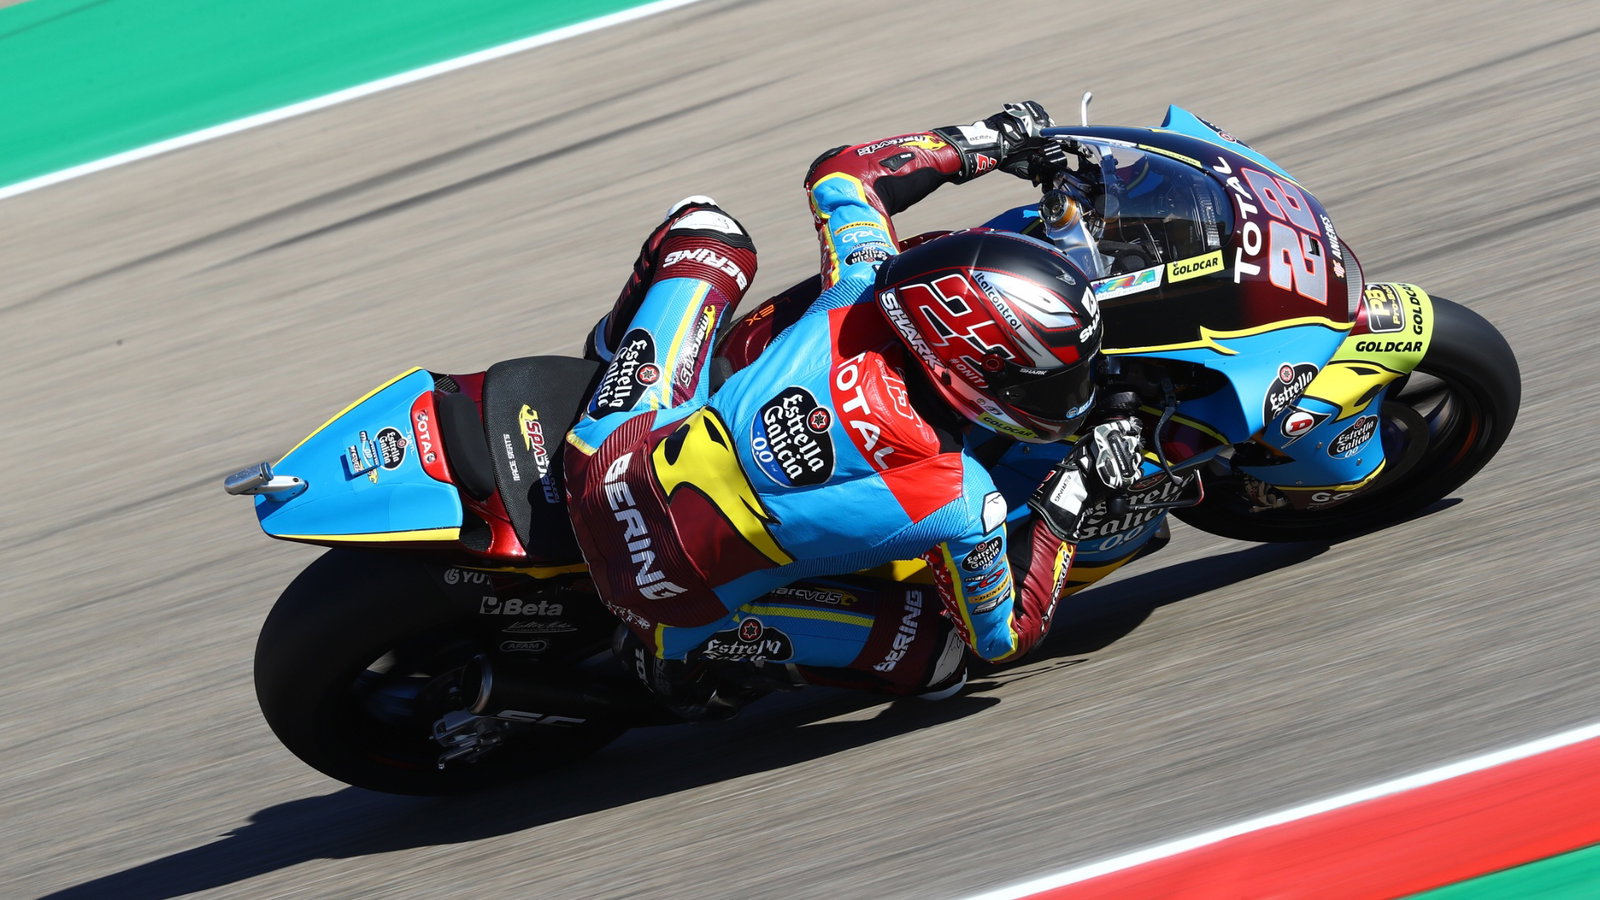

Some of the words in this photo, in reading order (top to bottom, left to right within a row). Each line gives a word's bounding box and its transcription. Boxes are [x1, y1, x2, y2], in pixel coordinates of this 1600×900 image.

[1212, 155, 1262, 284] TOTAL
[1240, 166, 1329, 306] 22
[662, 248, 748, 291] BERING
[1172, 256, 1219, 276] GOLDCAR
[973, 271, 1022, 331] Italcontrol
[880, 292, 948, 370] SHARK
[1079, 315, 1101, 343] SHA
[1355, 341, 1423, 352] GOLDCAR
[609, 339, 648, 408] Estrella
[1020, 367, 1048, 376] SHARK
[385, 430, 401, 462] Estrella
[764, 405, 804, 480] Galicia
[783, 394, 825, 472] Estrella
[1336, 431, 1371, 454] Galicia
[1337, 420, 1374, 444] Estrella
[604, 451, 689, 600] BERING
[966, 540, 1000, 565] Estrella
[970, 550, 1001, 570] Galicia
[503, 598, 563, 616] Beta
[770, 586, 843, 606] arcvds
[873, 590, 924, 672] BERING
[507, 642, 541, 651] AFAM
